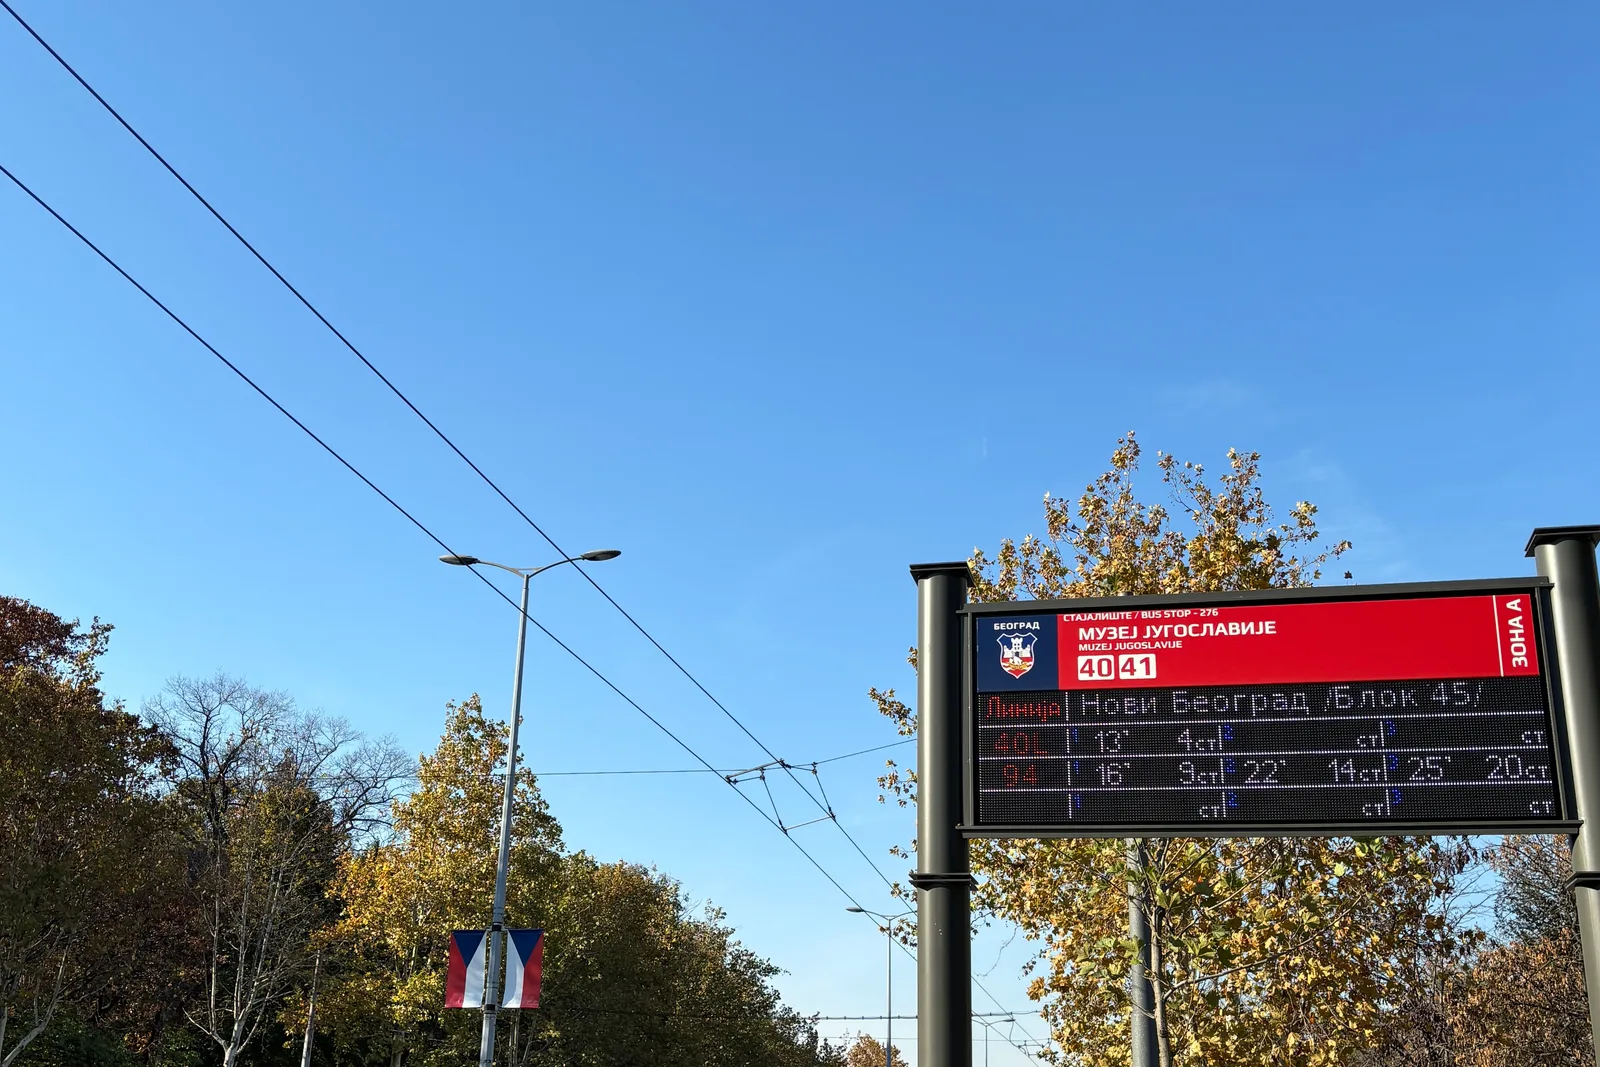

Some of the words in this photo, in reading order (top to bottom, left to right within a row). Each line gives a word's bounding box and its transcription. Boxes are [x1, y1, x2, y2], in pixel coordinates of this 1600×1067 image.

[1505, 598, 1522, 612] А
[1063, 611, 1133, 622] СТАЈАЛИШТЕ
[1141, 610, 1162, 619] BUS
[1164, 609, 1192, 618] STOP
[1200, 608, 1219, 617] 276
[993, 621, 1040, 631] БЕОГРАД
[1079, 624, 1138, 640] МУЗЕЈ
[1142, 621, 1277, 639] ЈУГОСЛАВИЈЕ
[1079, 642, 1113, 652] MUZEJ
[1114, 640, 1183, 651] JUGOSLAVIJE
[1507, 615, 1529, 668] ЗОНА
[1080, 657, 1112, 678] 40
[1121, 656, 1151, 677] 41
[986, 695, 1060, 722] Линија
[1081, 693, 1156, 715] Нови
[1172, 690, 1309, 717] Београд
[1003, 764, 1039, 787] 94
